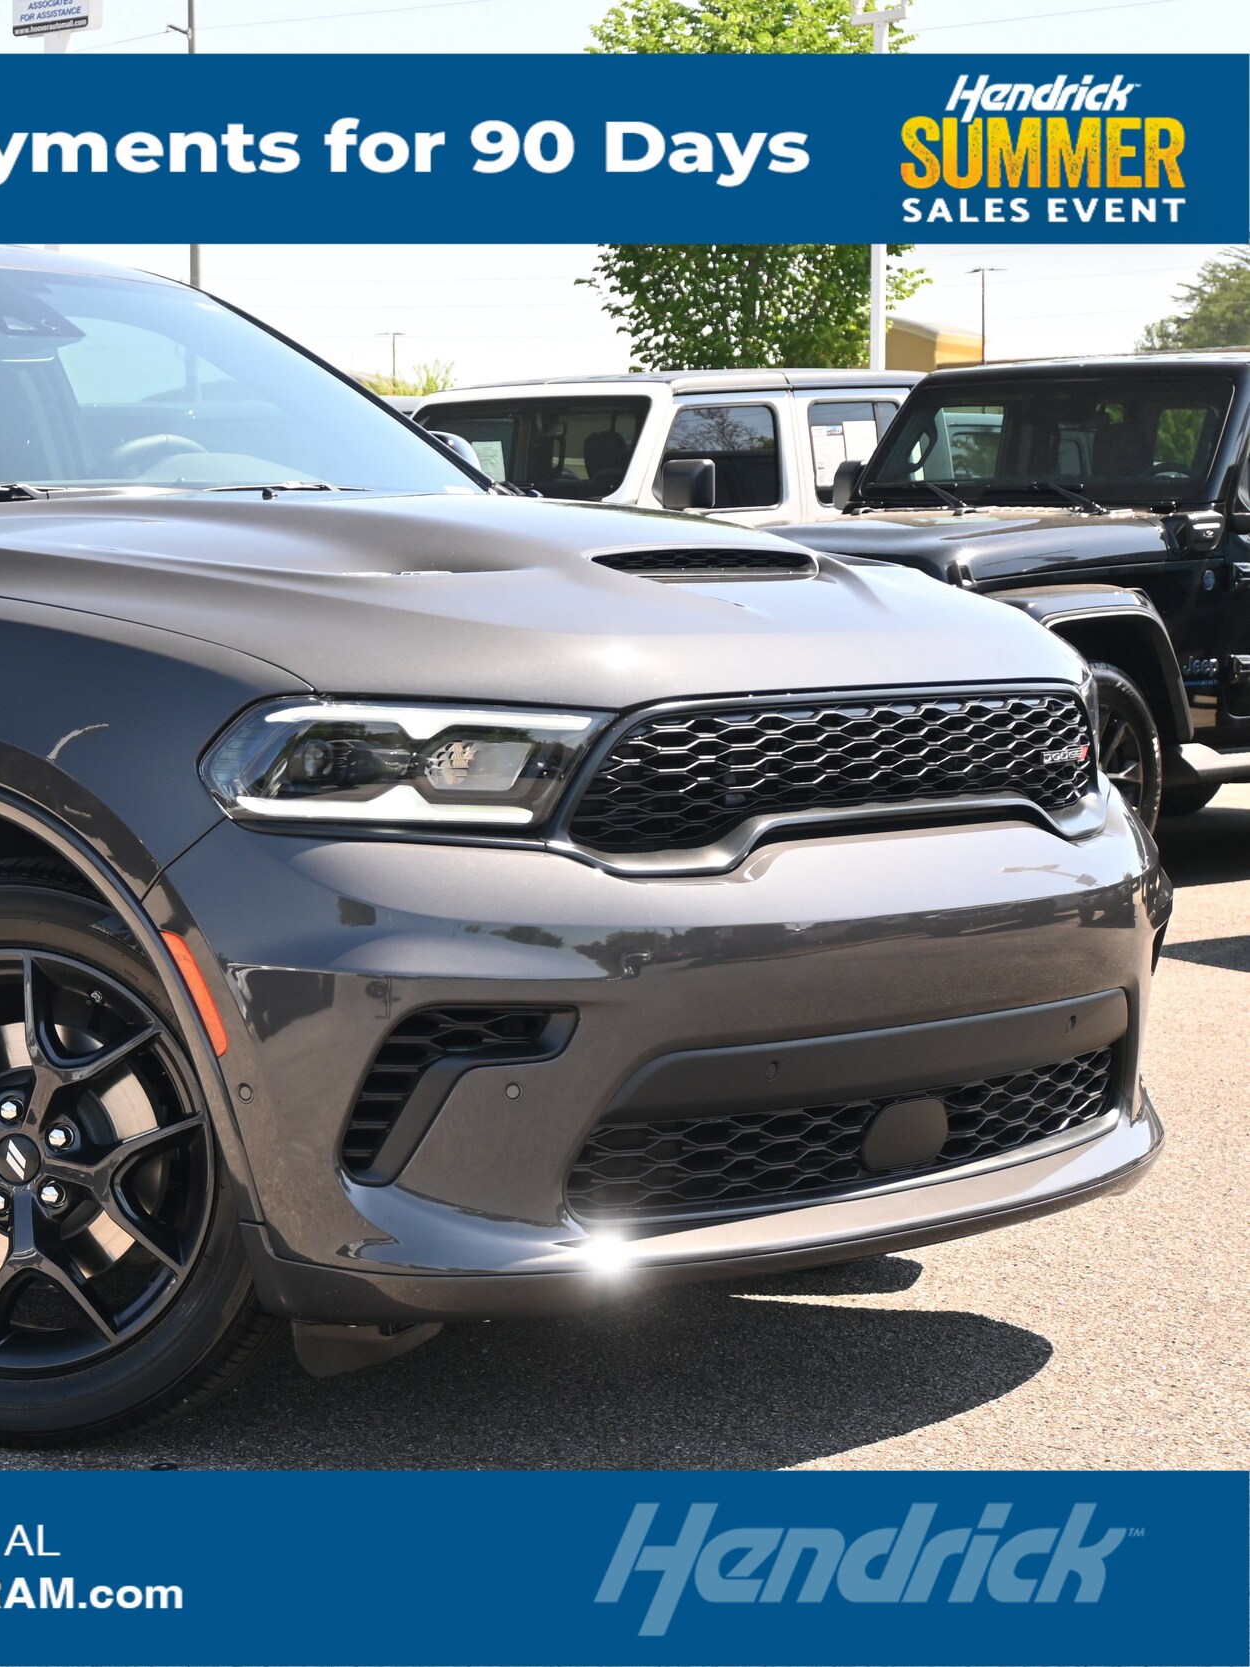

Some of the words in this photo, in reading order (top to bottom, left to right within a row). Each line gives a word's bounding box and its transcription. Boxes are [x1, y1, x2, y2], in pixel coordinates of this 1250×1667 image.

[20, 13, 35, 22] FOR
[36, 6, 81, 19] ASSISTANCE
[1182, 655, 1219, 677] Jeep
